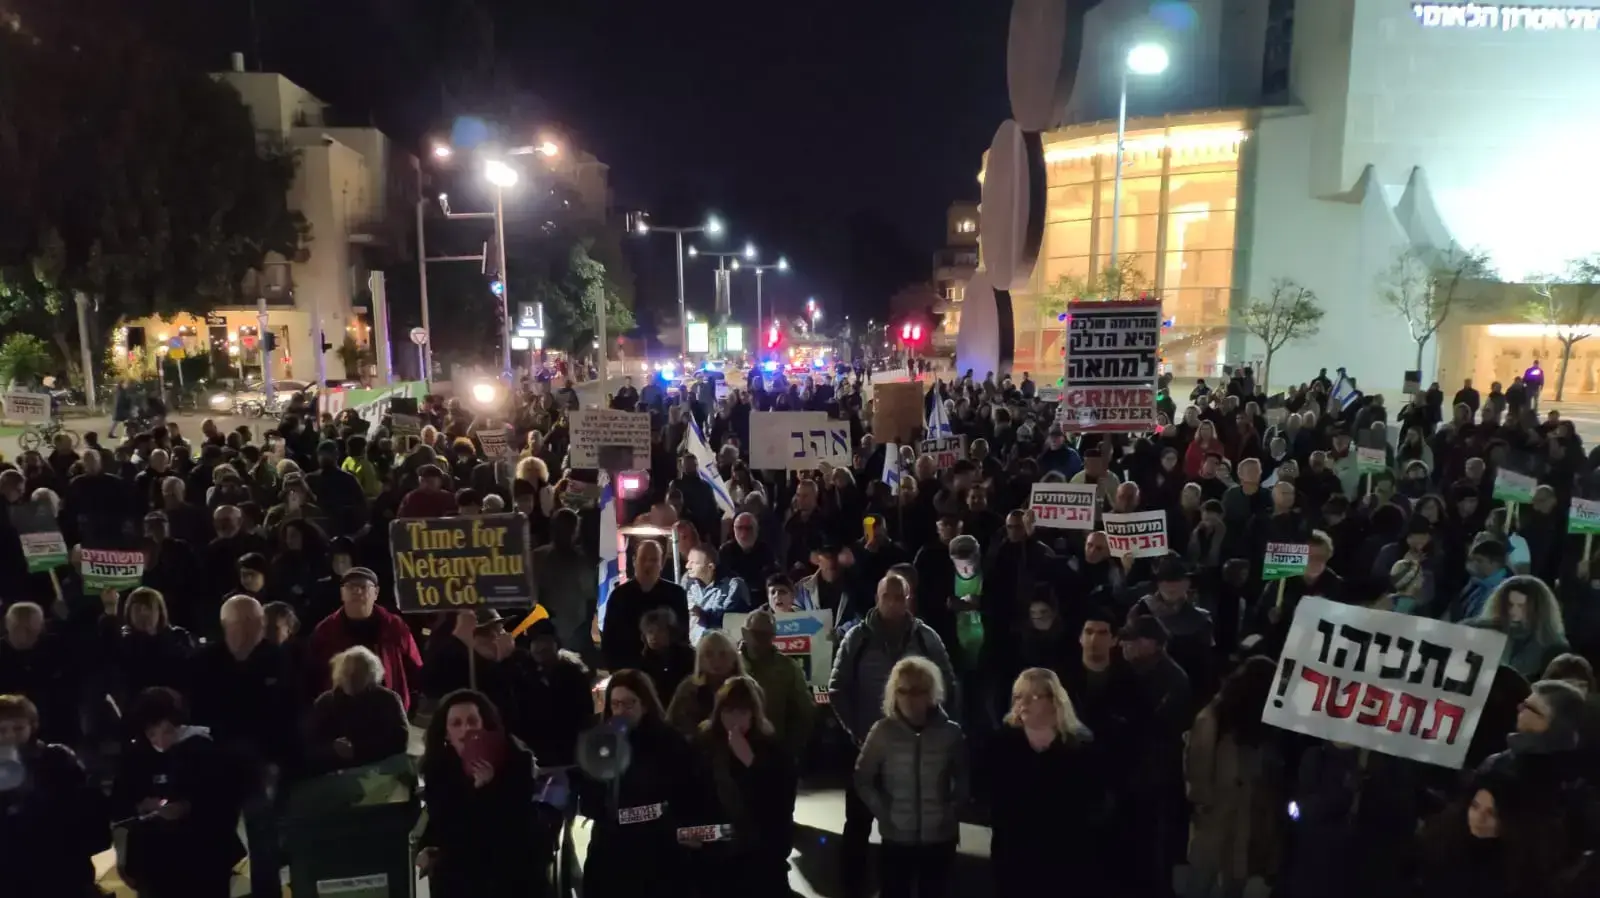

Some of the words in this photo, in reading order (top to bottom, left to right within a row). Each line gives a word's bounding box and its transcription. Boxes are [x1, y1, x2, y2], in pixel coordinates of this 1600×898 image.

[1110, 318, 1157, 329] התרומה
[1070, 330, 1118, 350] הדלק
[1124, 332, 1156, 346] היא
[1068, 352, 1155, 378] למחאה
[1067, 389, 1154, 408] CRIME
[1034, 492, 1092, 504] מושחתים
[406, 519, 466, 550] Time
[472, 519, 508, 548] for
[1107, 520, 1162, 534] מושחתים
[1109, 533, 1165, 550] הביתה
[81, 549, 144, 563] מושחתים
[91, 564, 138, 576] הביתה!
[396, 548, 524, 583] Netanyahu
[416, 581, 440, 606] to
[445, 577, 486, 606] Go.
[1317, 618, 1484, 696] נתניהו
